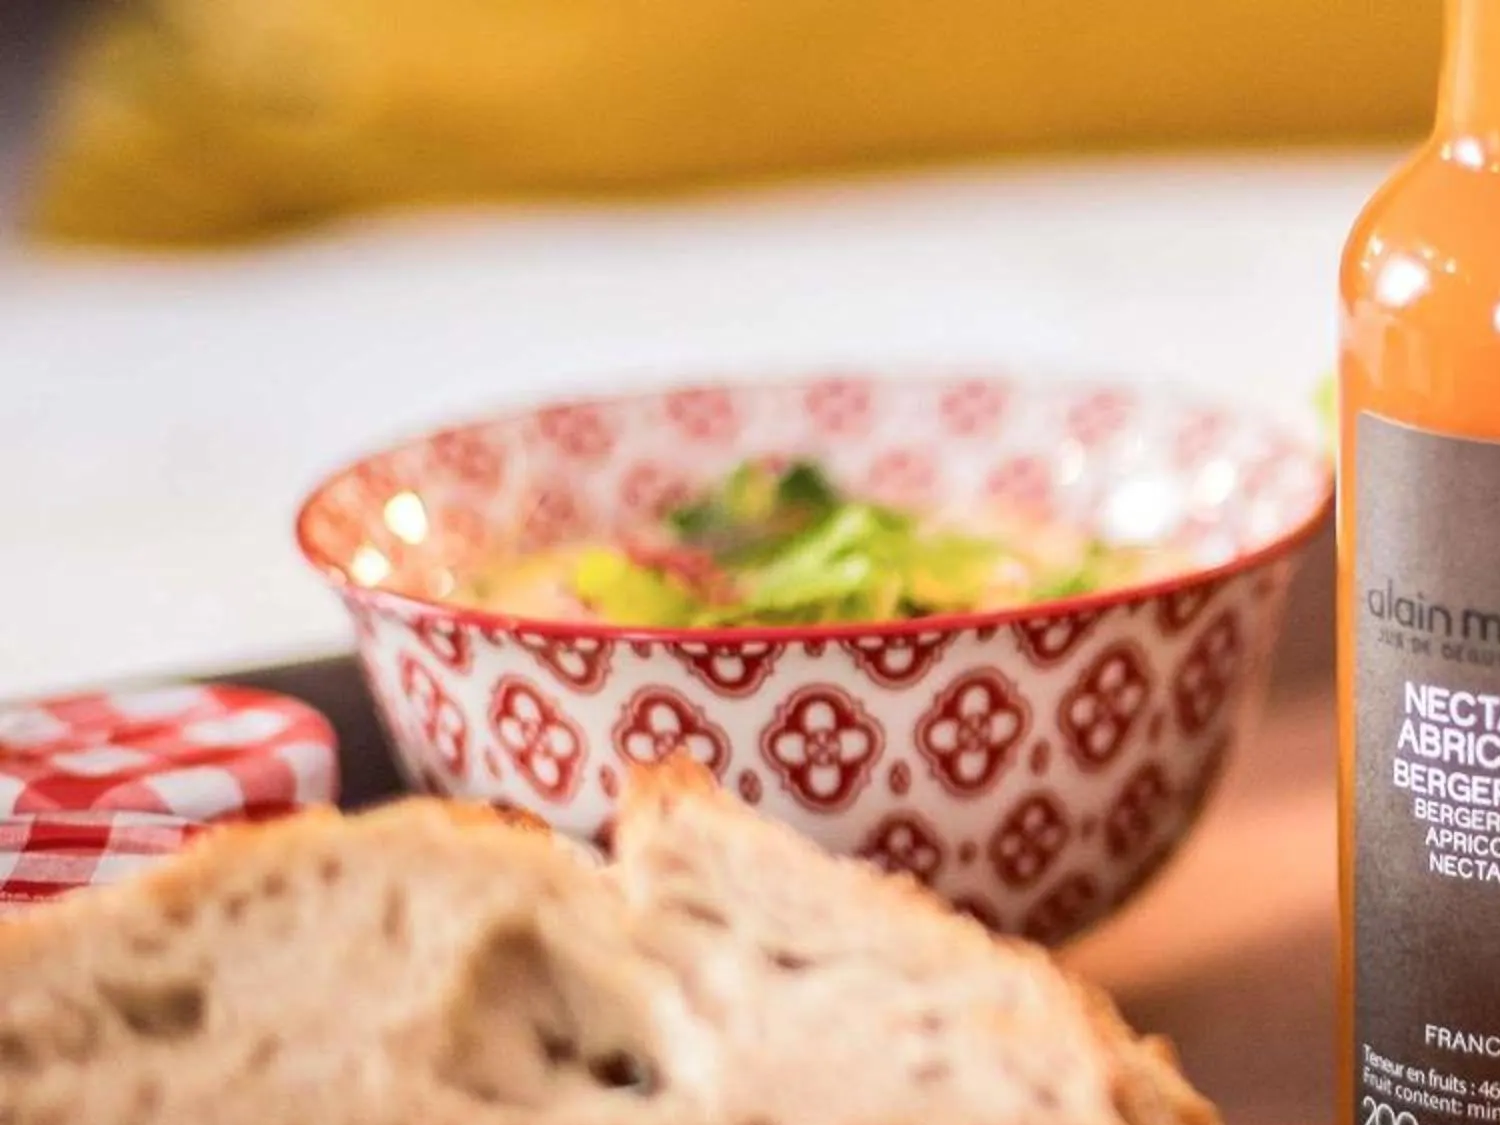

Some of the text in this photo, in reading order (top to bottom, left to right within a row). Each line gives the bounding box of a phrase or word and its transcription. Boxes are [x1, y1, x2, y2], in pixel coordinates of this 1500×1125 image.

[1367, 579, 1452, 636] alain
[1363, 1043, 1404, 1077] Teneur
[1406, 1066, 1425, 1084] en
[1428, 1068, 1467, 1095] fruits
[1363, 1066, 1392, 1095] Fruit
